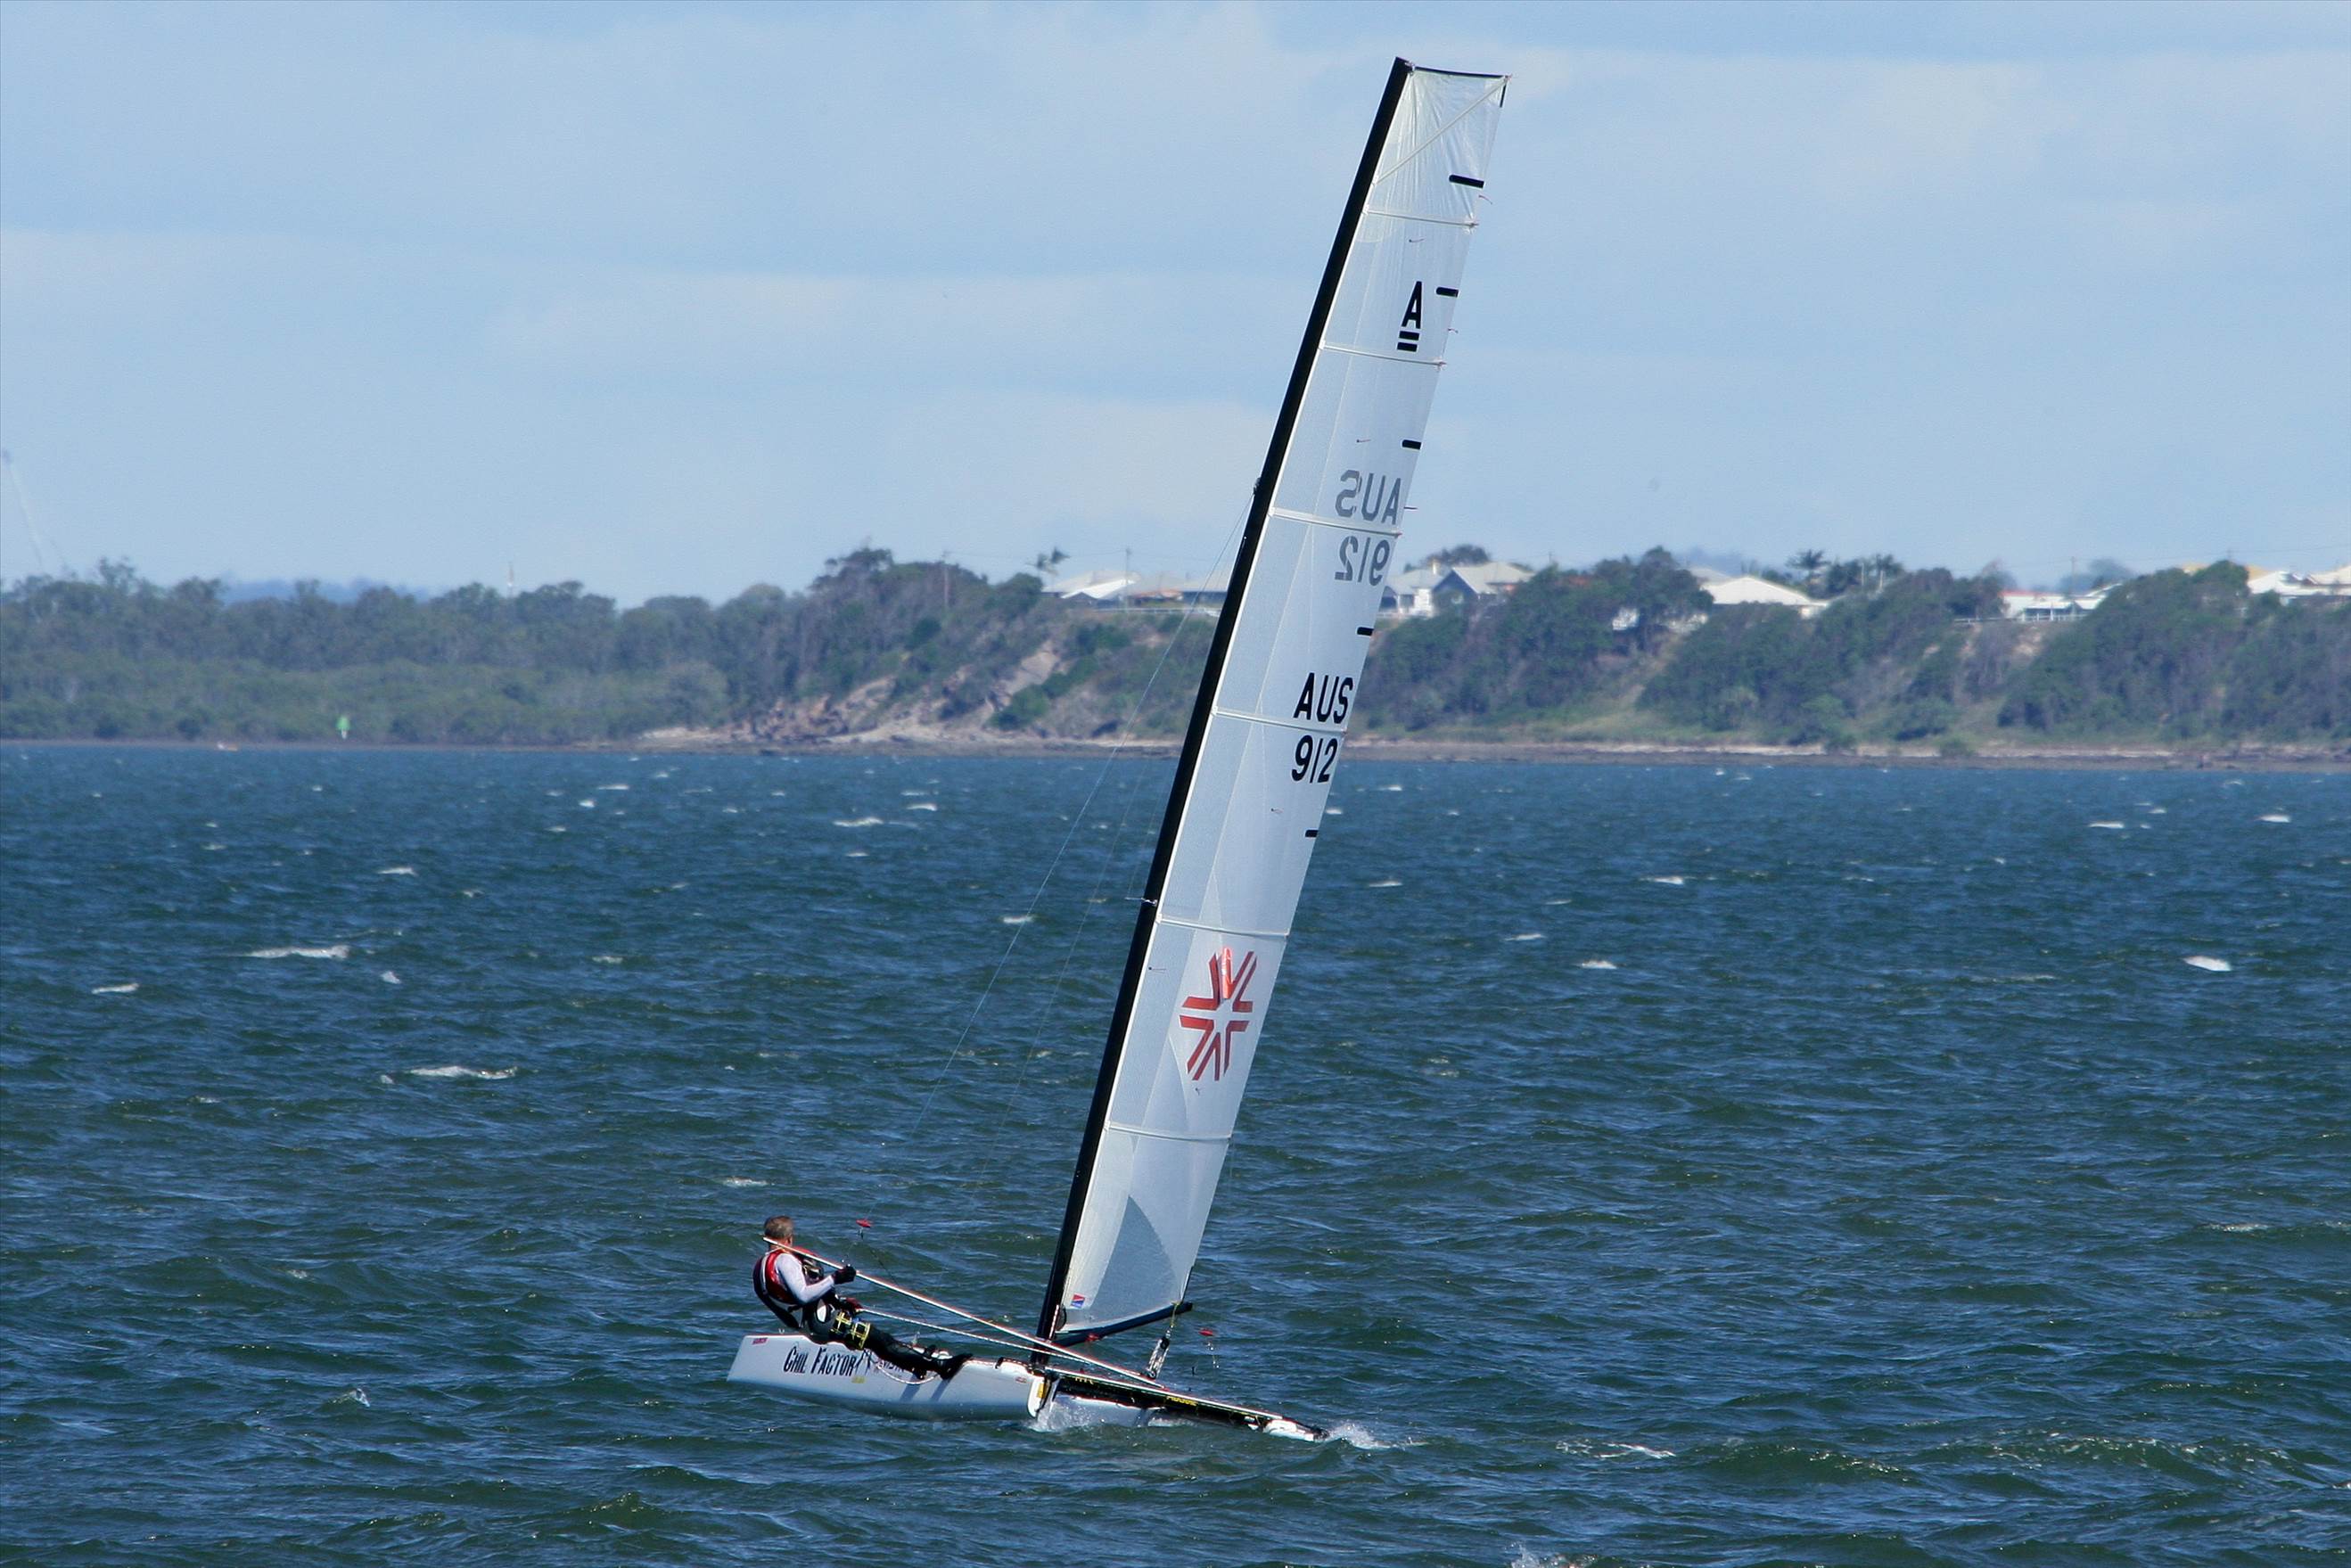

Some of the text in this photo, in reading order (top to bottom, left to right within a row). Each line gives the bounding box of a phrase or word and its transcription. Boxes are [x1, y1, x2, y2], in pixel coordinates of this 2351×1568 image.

[1401, 280, 1423, 330] A
[1293, 672, 1354, 725] AUS
[1291, 735, 1339, 784] 912
[810, 1346, 858, 1377] FACTOR
